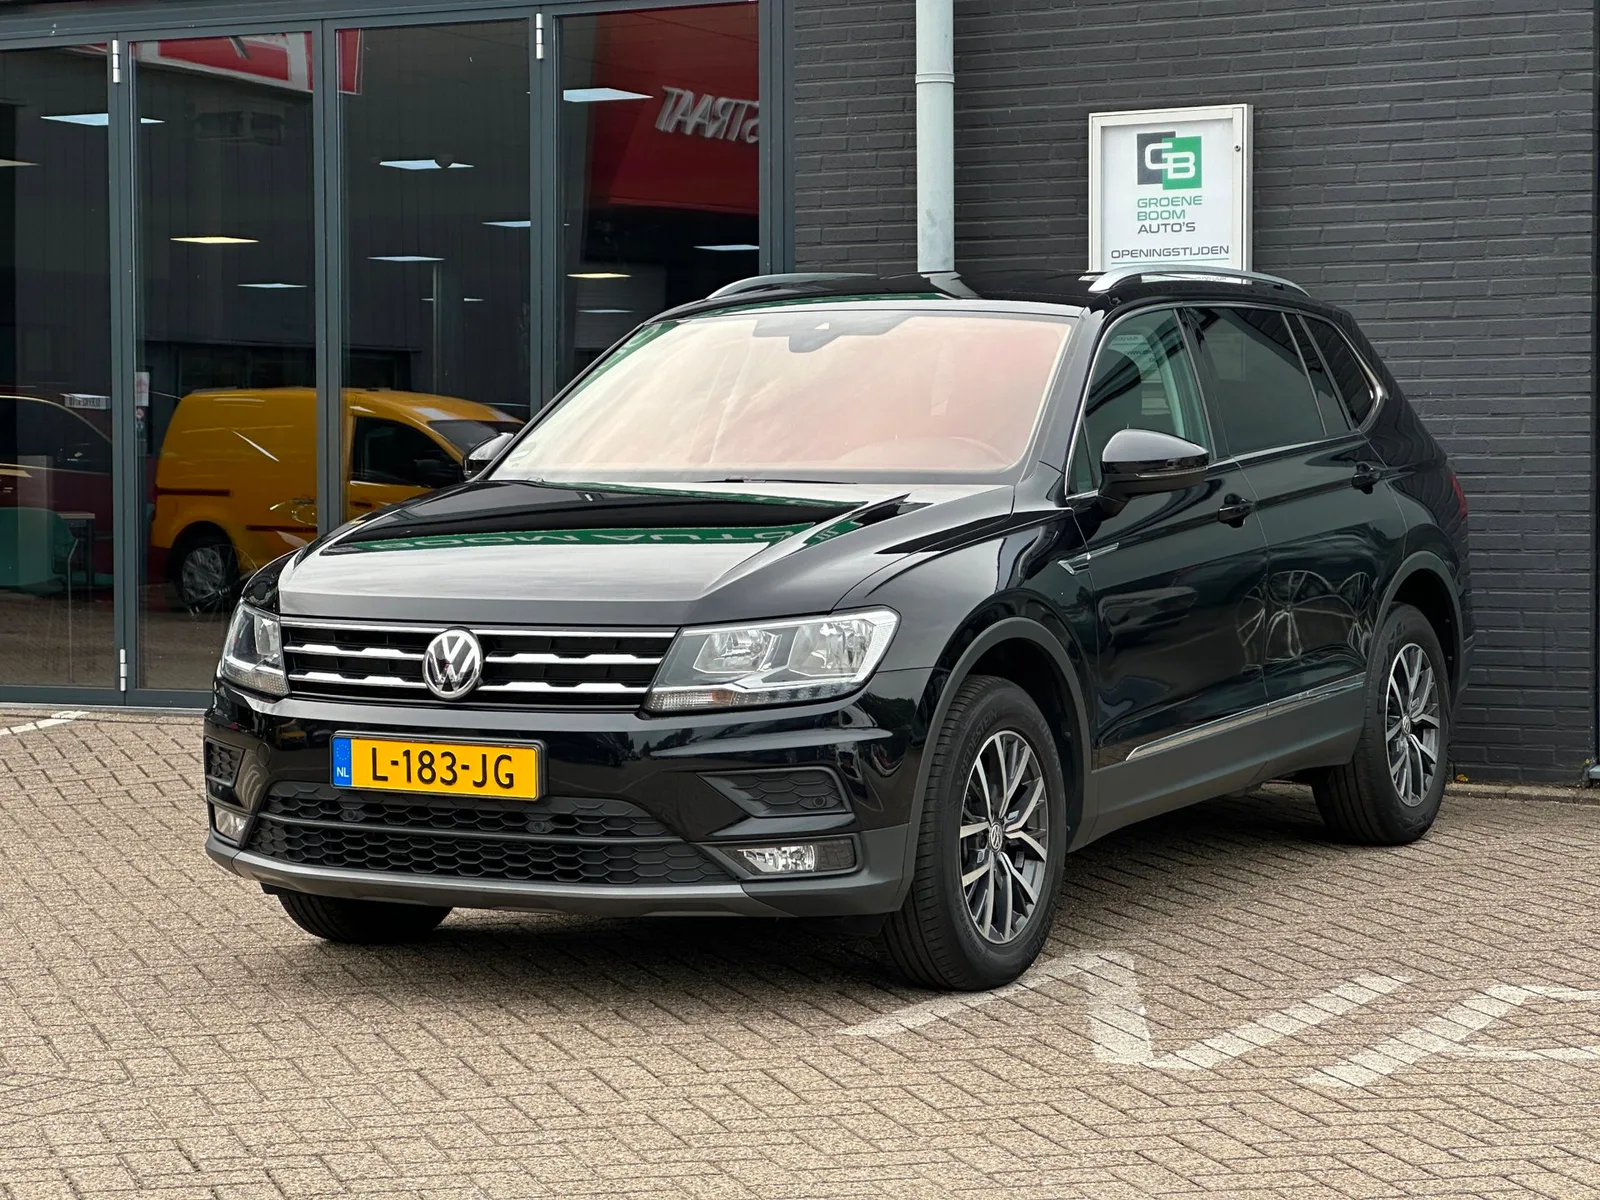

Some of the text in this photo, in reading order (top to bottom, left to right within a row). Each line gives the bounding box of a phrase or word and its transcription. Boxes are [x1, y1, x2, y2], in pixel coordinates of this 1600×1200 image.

[1137, 195, 1203, 208] GROENE
[1137, 209, 1186, 221] BOOM
[1137, 222, 1196, 234] AUTO'S
[1111, 245, 1229, 259] OPENINGSTIJDEN
[336, 766, 350, 778] NL
[371, 747, 514, 790] L-183-JG
